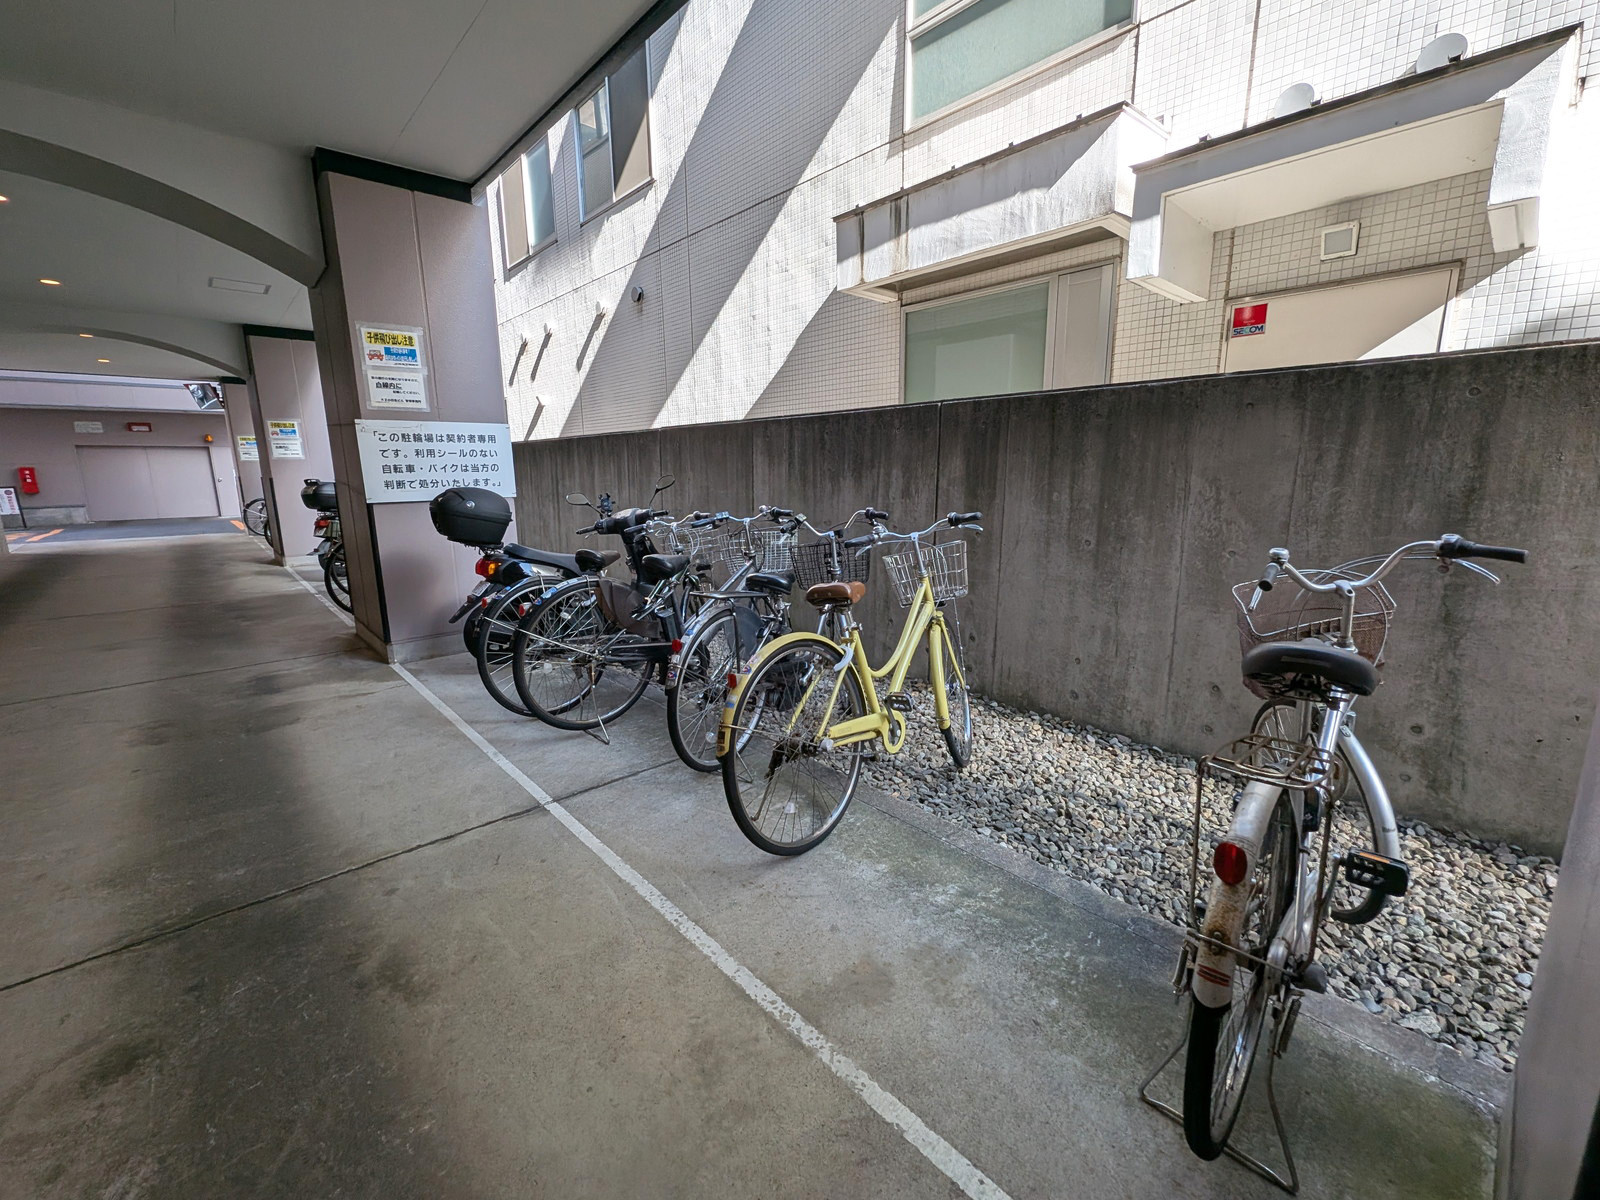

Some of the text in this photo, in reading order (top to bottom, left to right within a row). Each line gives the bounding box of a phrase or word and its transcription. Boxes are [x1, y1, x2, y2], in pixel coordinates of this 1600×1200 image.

[1233, 325, 1263, 335] SECOM
[373, 431, 497, 443] 「この駐輪場は契約者専用
[379, 448, 498, 458] です。利用シールのない
[382, 463, 499, 474] 自転車・バイクは当方の
[384, 478, 501, 490] 判断で処分いたします。」
